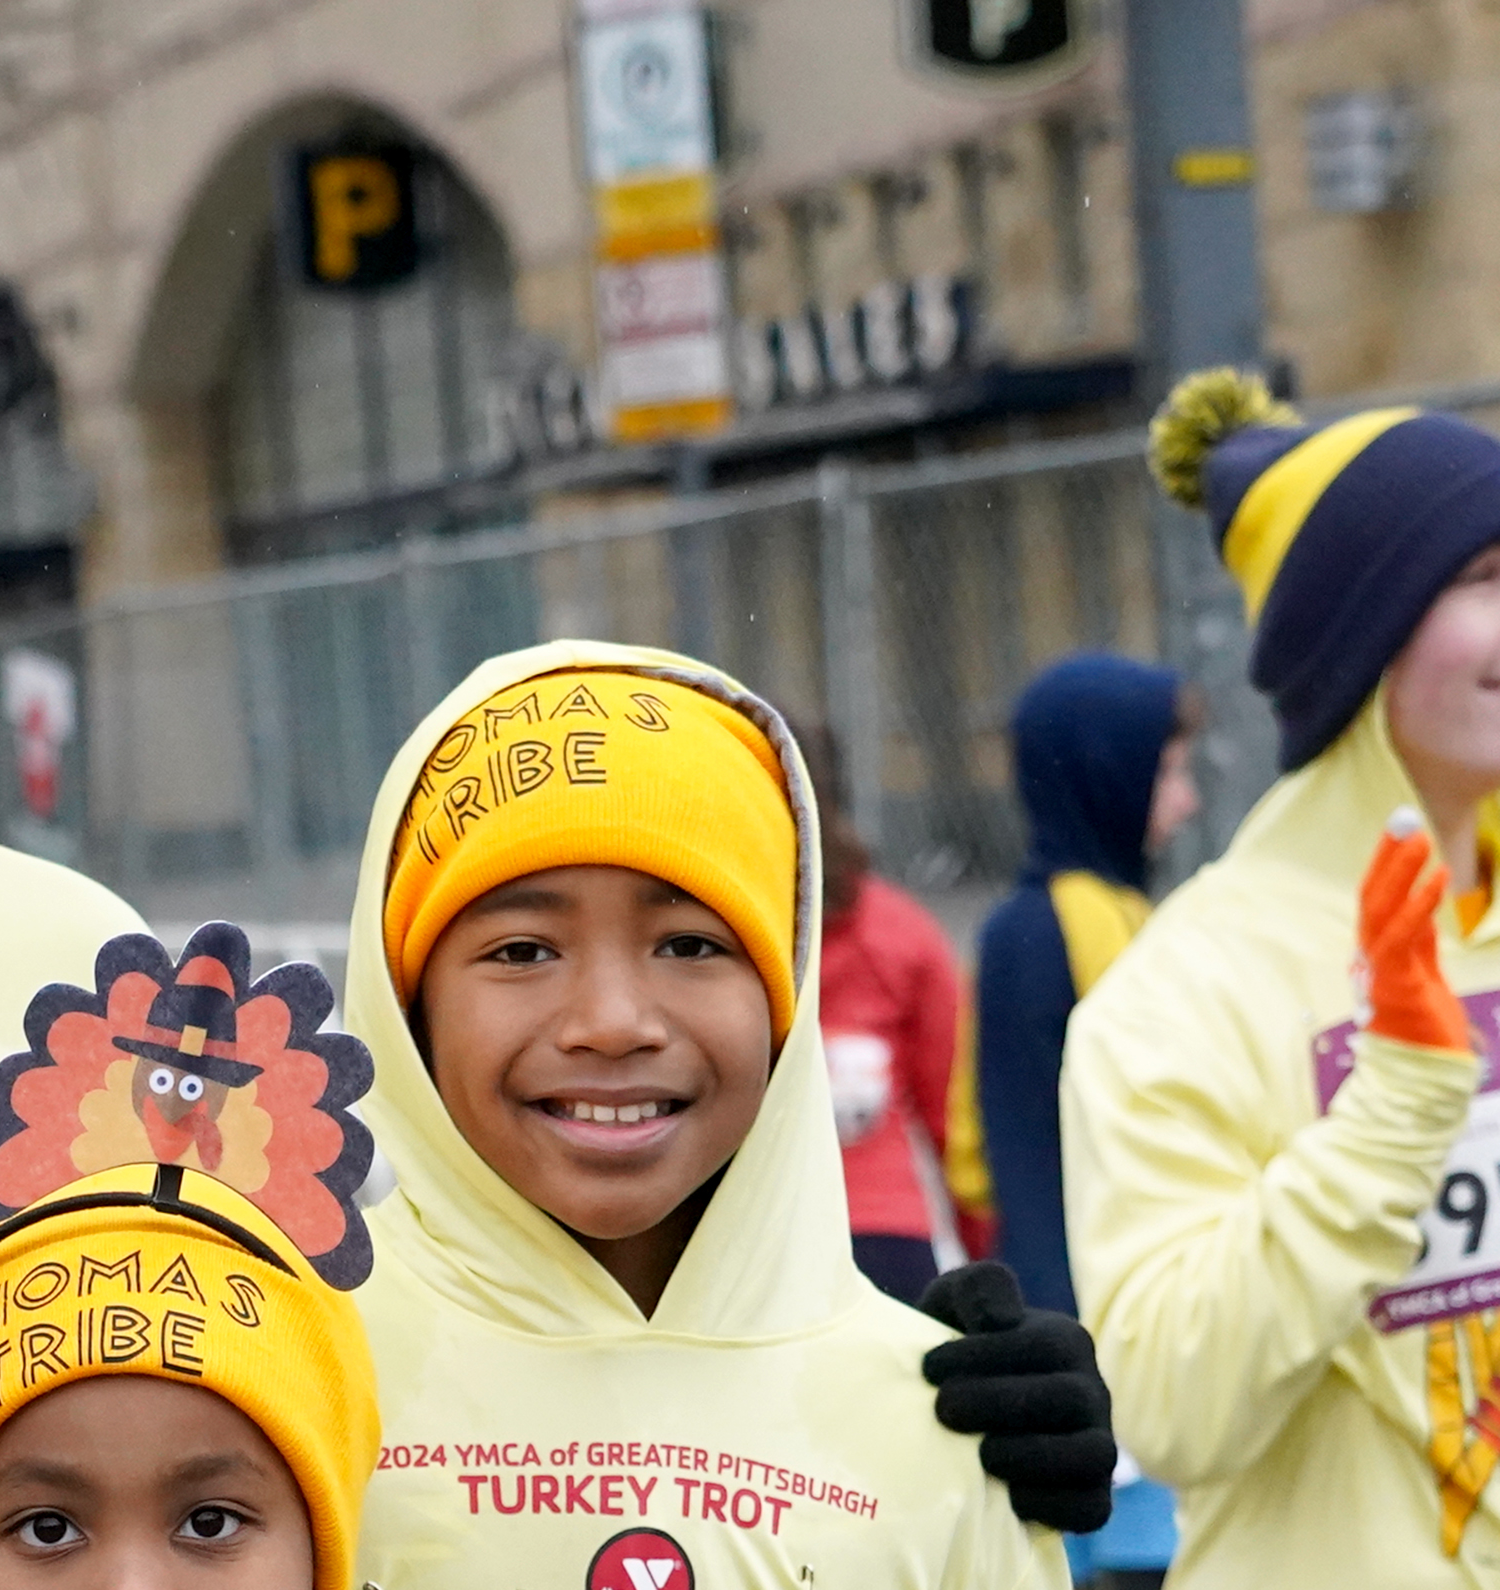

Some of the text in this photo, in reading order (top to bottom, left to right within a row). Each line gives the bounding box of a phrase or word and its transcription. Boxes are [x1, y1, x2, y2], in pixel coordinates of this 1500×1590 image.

[310, 155, 399, 281] P
[376, 1442, 879, 1520] 2024 YMCA of GREATER PITTSBURGH
[457, 1475, 792, 1535] TURKEY TROT
